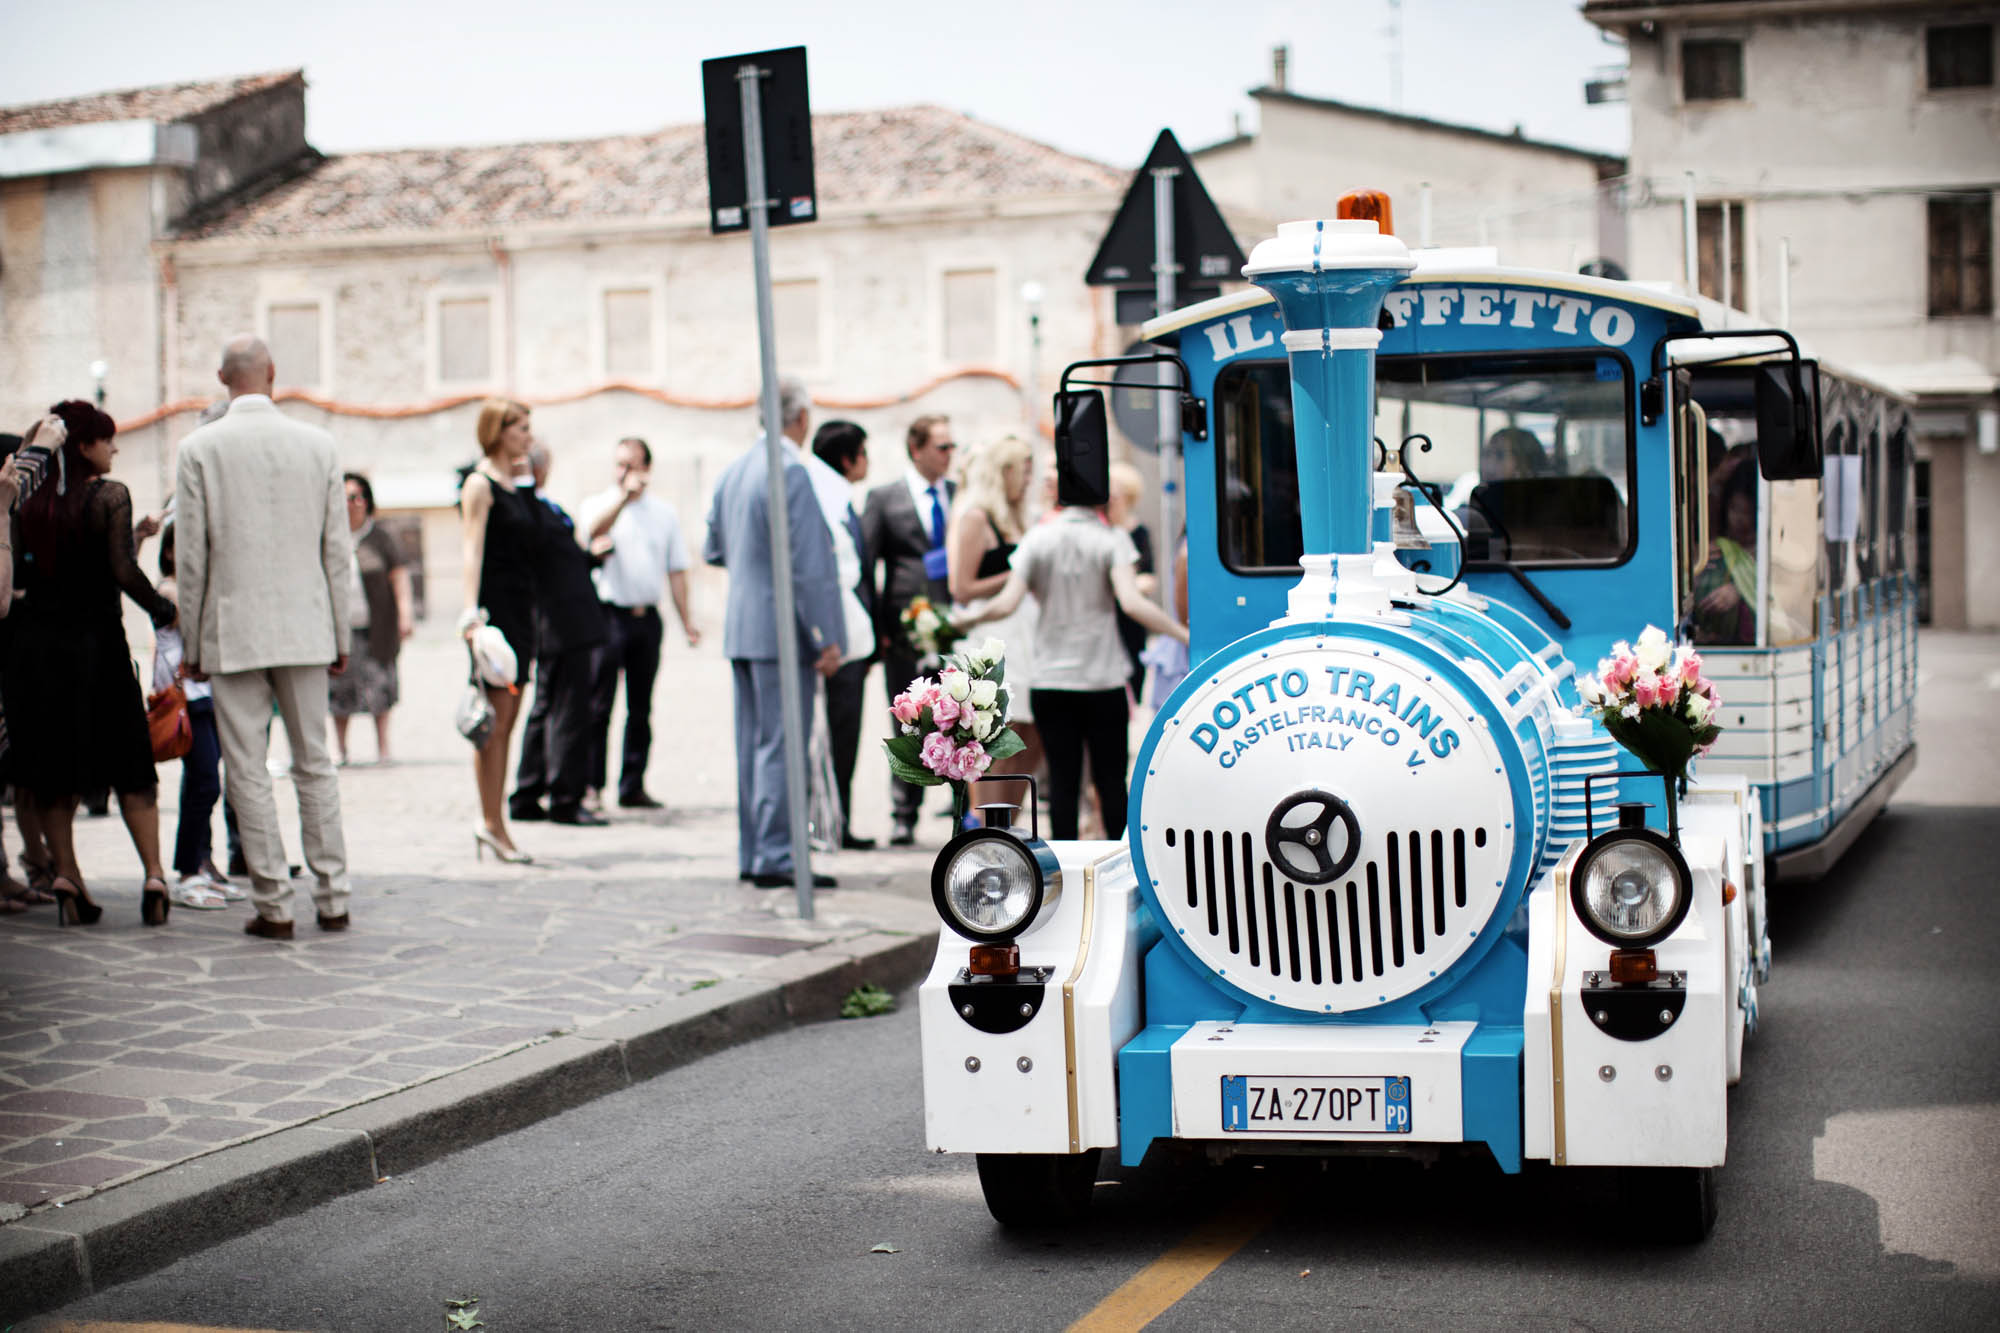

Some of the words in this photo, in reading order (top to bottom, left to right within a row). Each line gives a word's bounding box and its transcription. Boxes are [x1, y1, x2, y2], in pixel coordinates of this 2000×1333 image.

[1204, 314, 1274, 361] IL
[1384, 288, 1636, 347] FFETTO
[1189, 667, 1309, 754] DOTTO
[1325, 665, 1460, 759] TRAINS
[1218, 705, 1401, 769] CASTELFRANCO
[1287, 731, 1354, 752] ITALY
[1232, 1105, 1238, 1125] I
[1250, 1088, 1283, 1121] ZA
[1293, 1088, 1380, 1121] 270PT
[1387, 1105, 1408, 1125] PD
